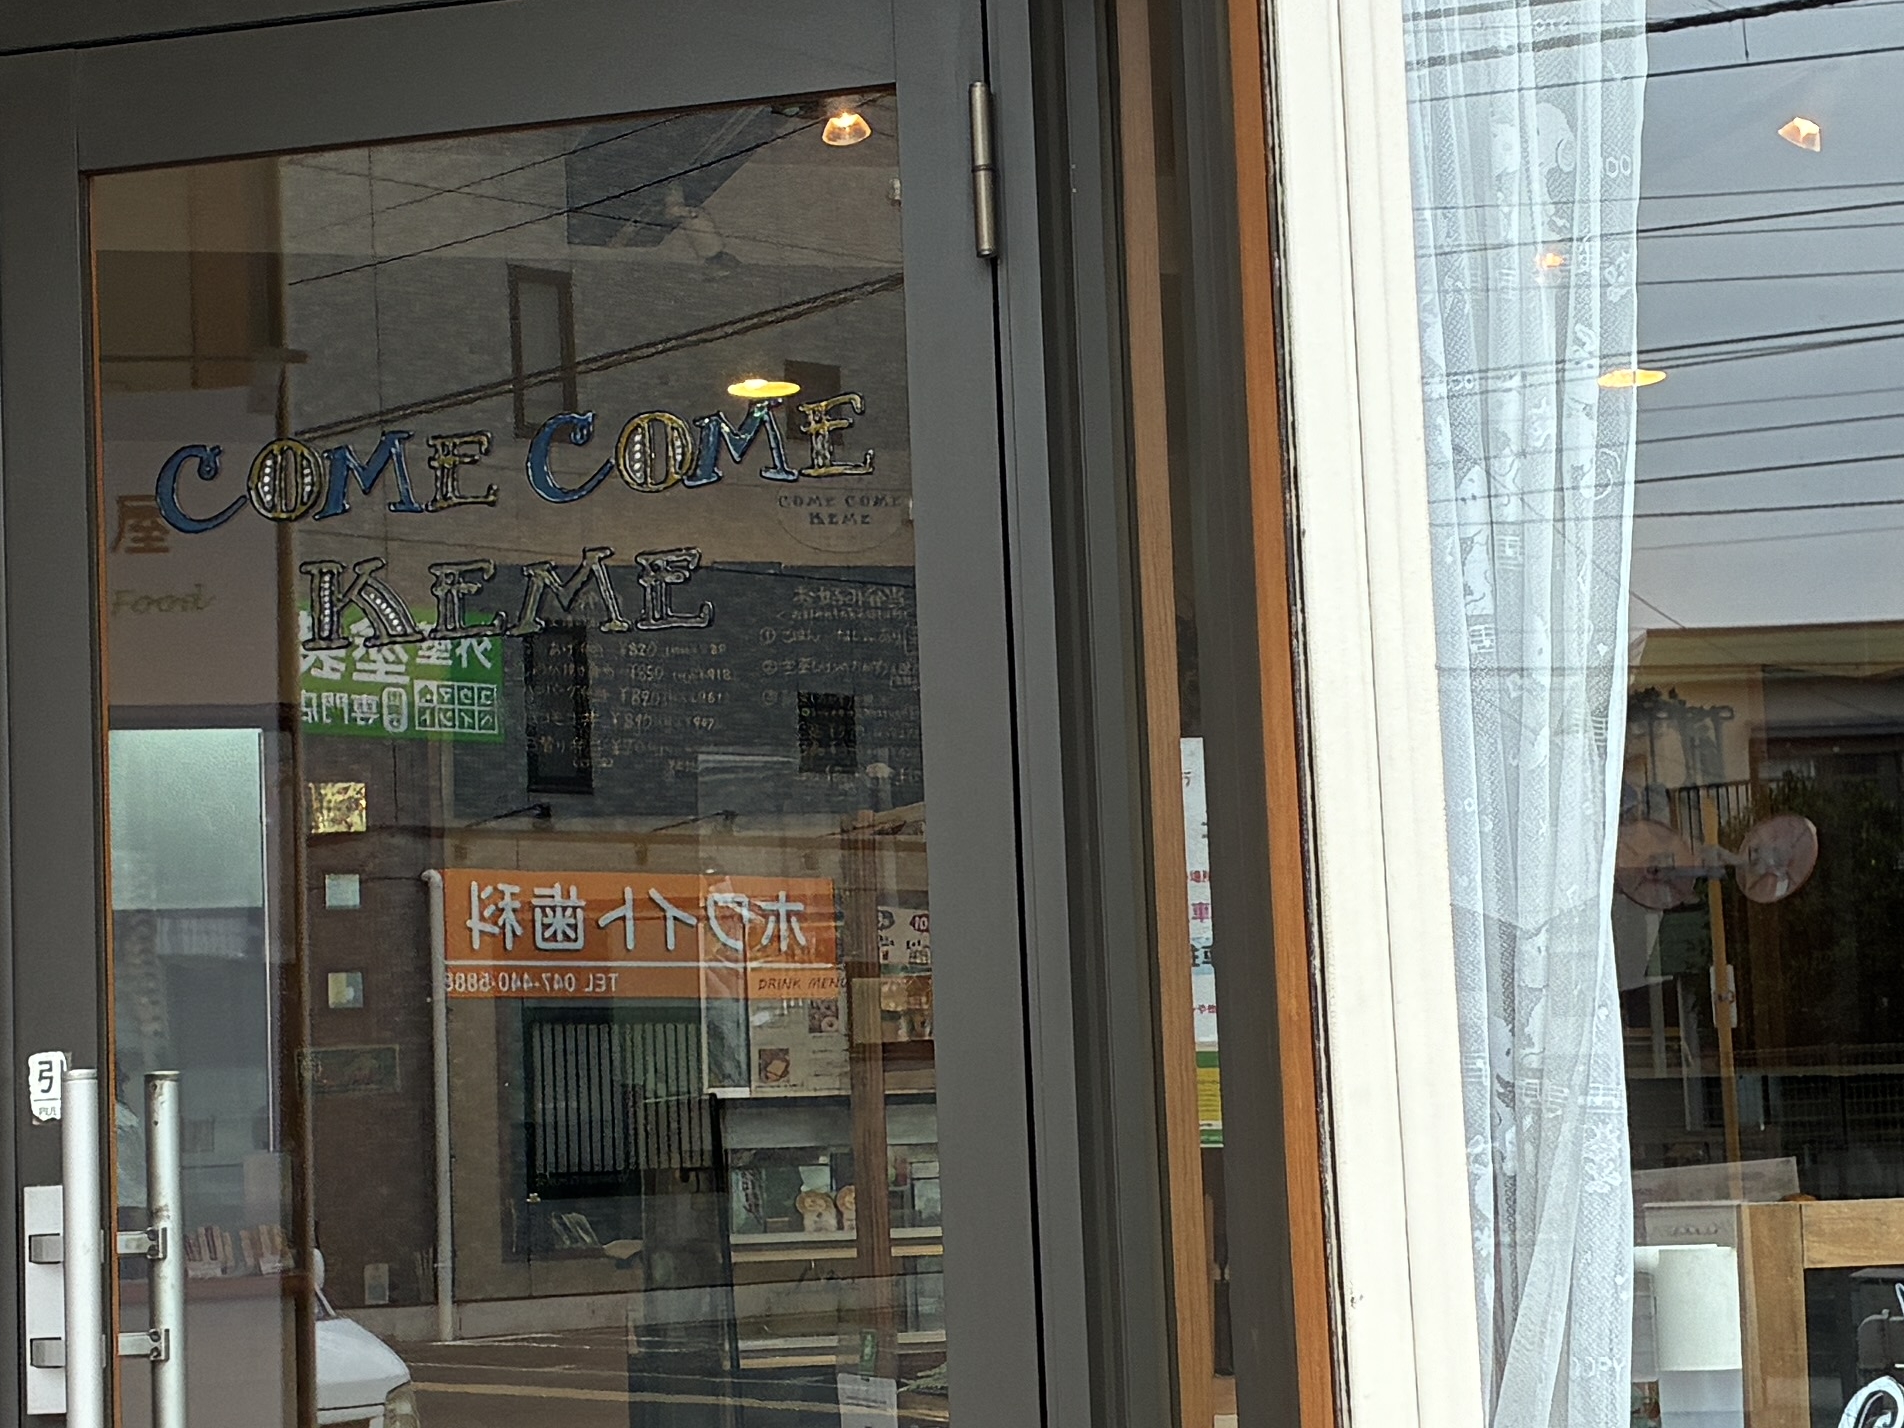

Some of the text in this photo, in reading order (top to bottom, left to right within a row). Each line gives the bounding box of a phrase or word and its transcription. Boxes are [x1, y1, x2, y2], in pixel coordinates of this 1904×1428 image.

[153, 390, 876, 534] COME COME
[298, 545, 716, 652] KEME
[757, 977, 801, 992] DRINK
